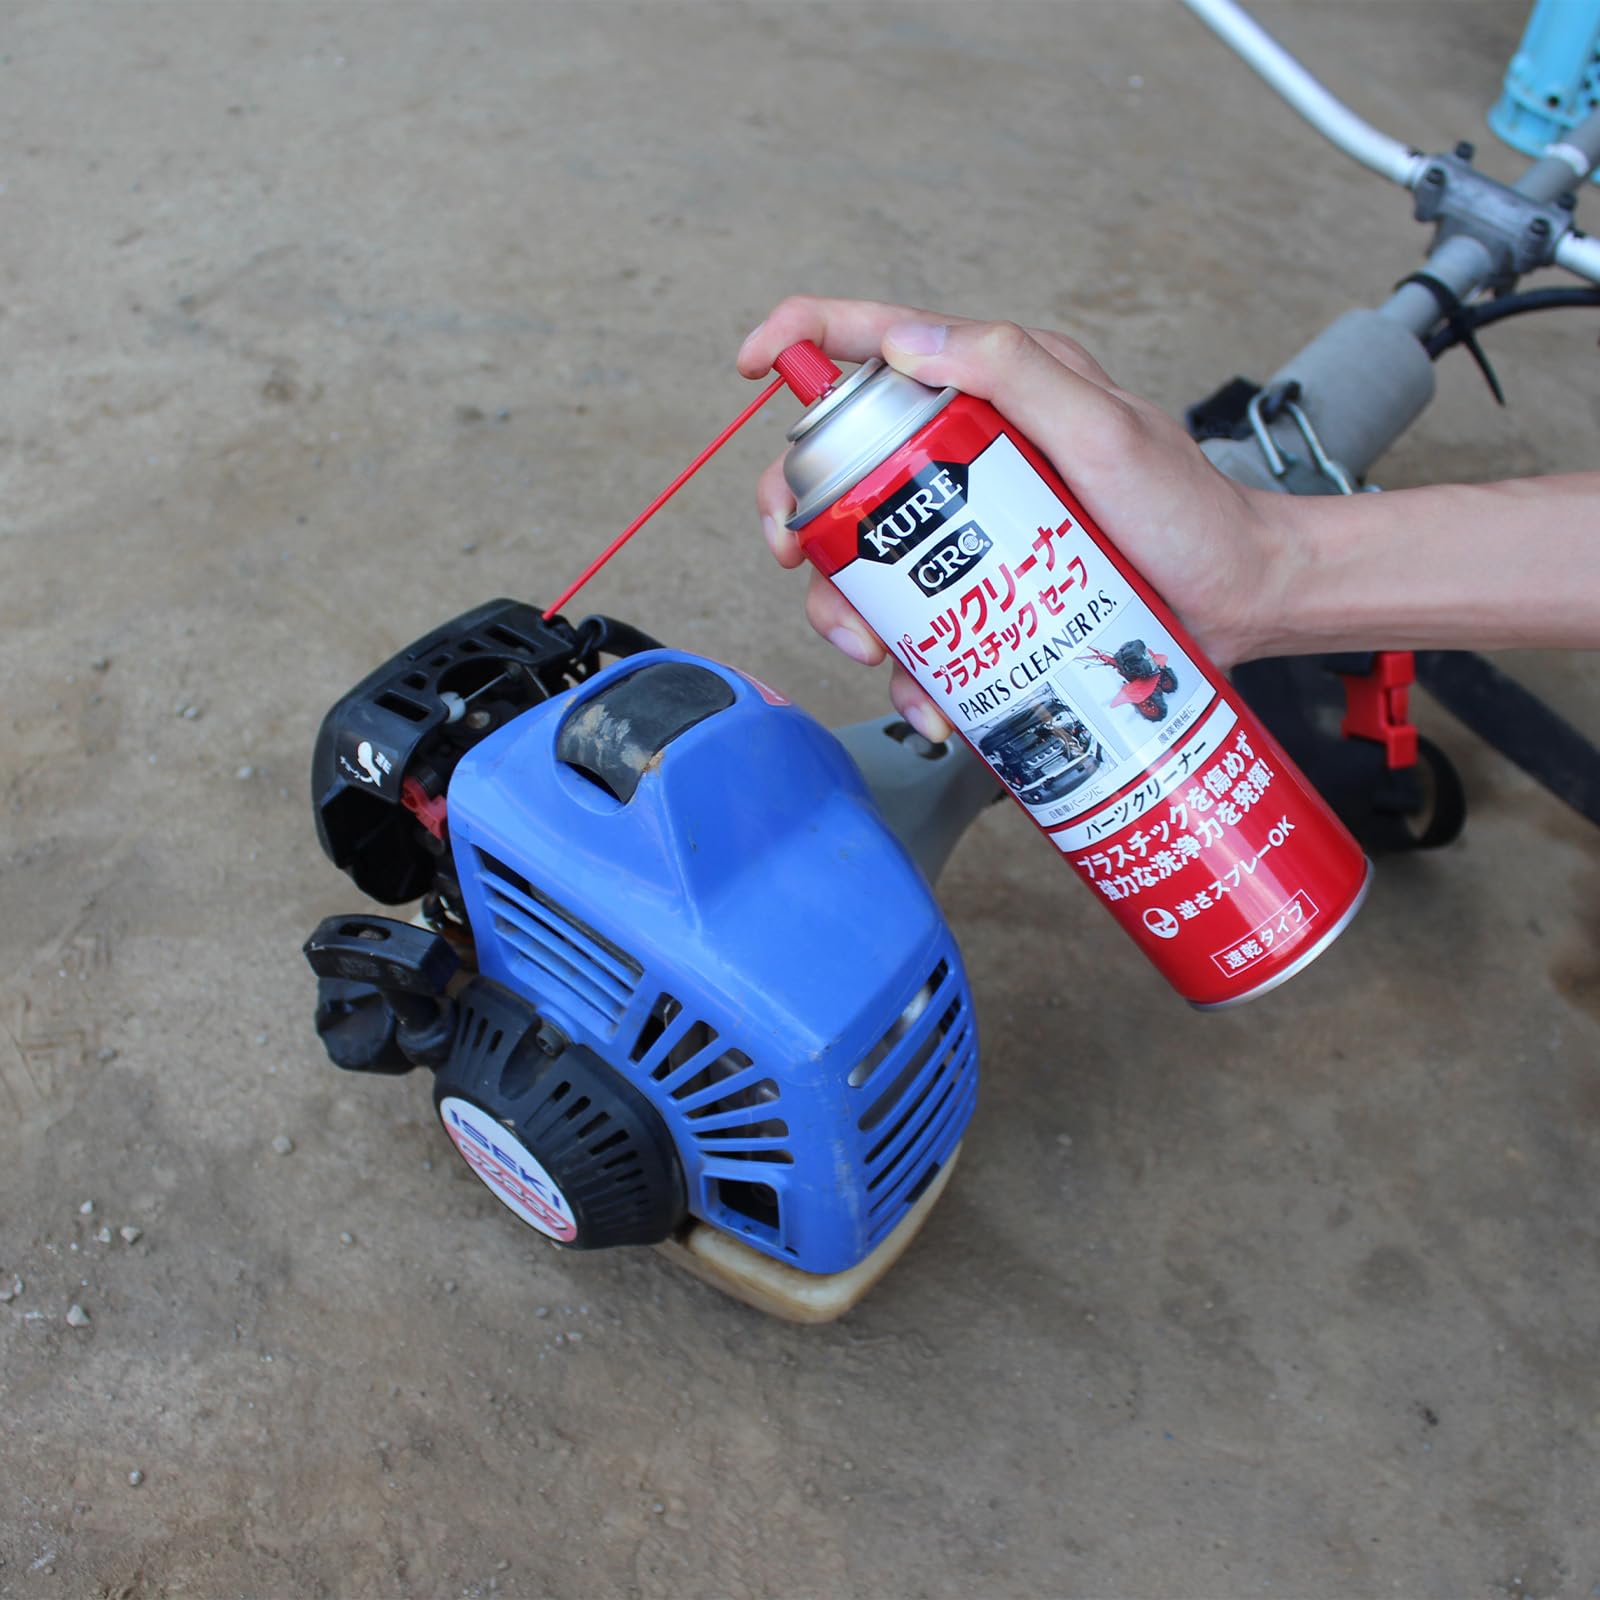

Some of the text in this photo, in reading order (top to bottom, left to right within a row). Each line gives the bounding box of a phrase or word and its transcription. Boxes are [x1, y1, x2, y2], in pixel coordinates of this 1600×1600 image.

[864, 468, 963, 557] KURE
[918, 527, 985, 588] CRC
[897, 518, 1073, 672] パーツクリーナー
[932, 555, 1088, 696] プラスチック セーフ
[958, 589, 1118, 722] PARTS CLEANER P.S.
[1077, 730, 1255, 879] プラスチックを傷めず
[1086, 741, 1206, 840] パーツクリーナー
[1096, 757, 1275, 901] 強力な洗浄力を発揮!
[1175, 815, 1296, 921] 逆さスプレーOK
[1223, 900, 1304, 970] 速乾タイプ
[450, 1108, 562, 1210] ISEKI
